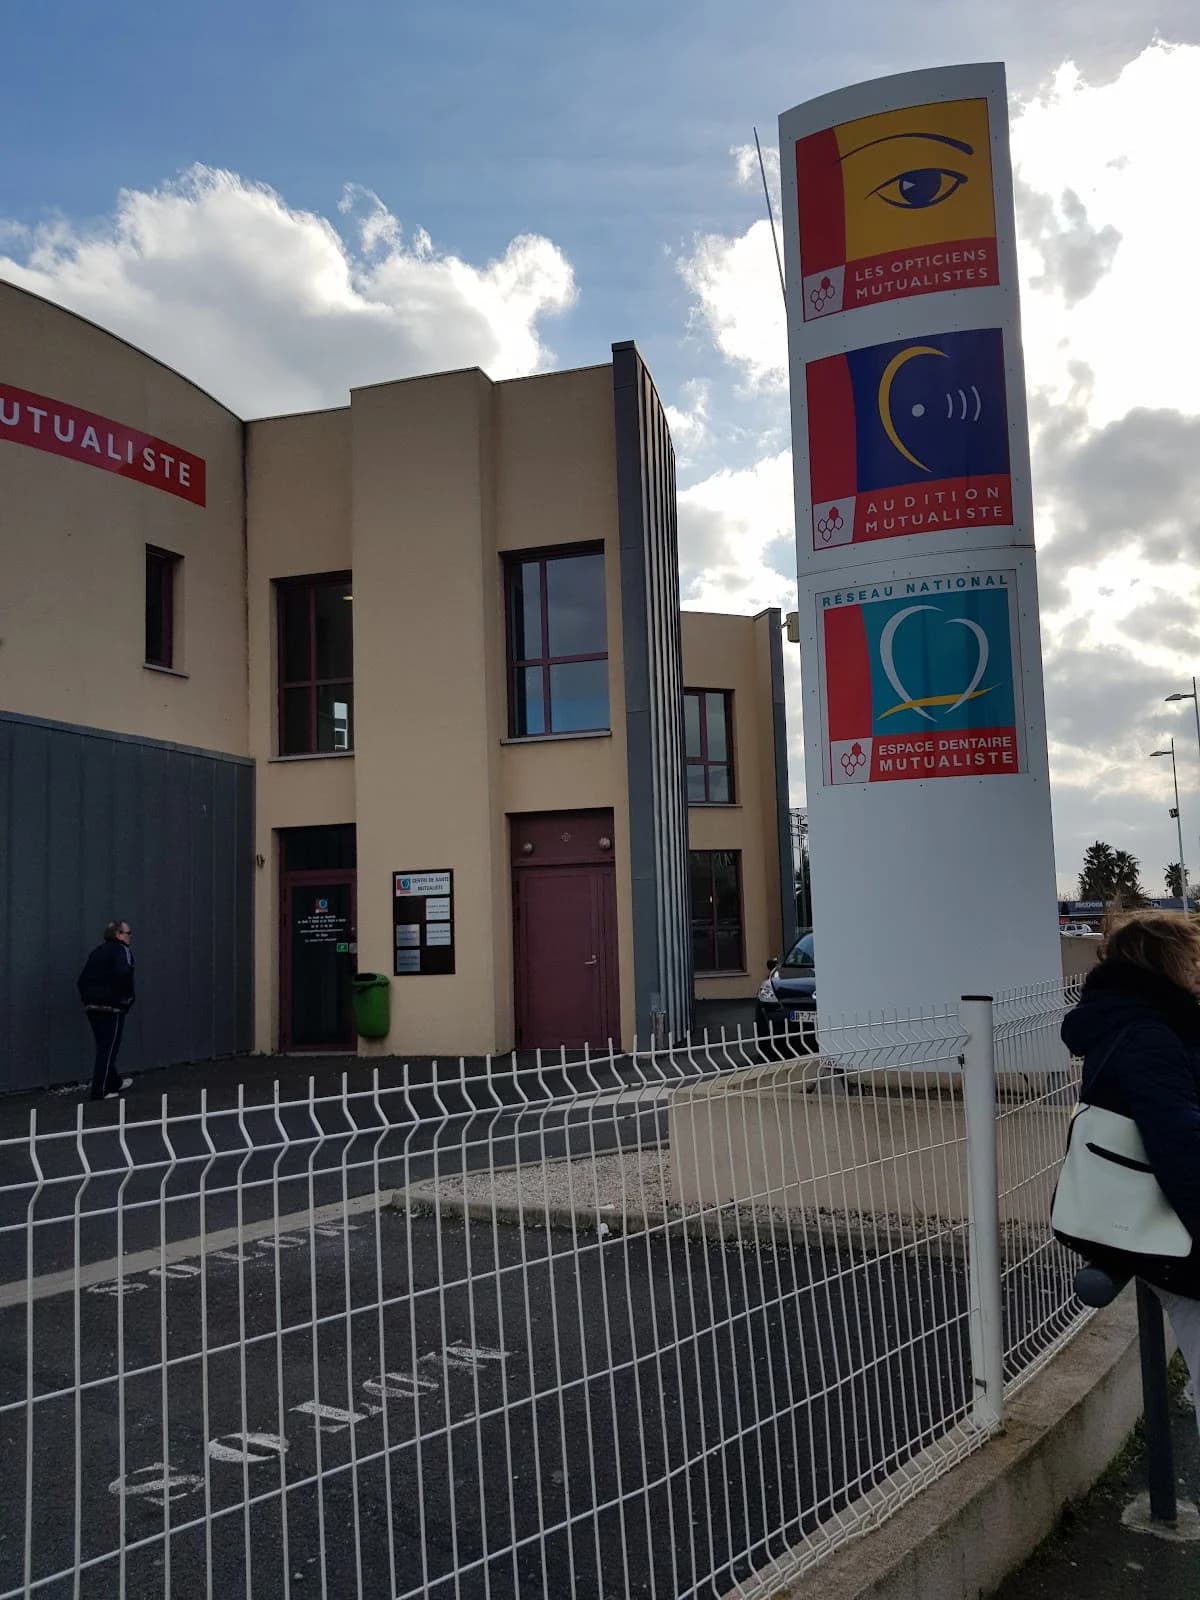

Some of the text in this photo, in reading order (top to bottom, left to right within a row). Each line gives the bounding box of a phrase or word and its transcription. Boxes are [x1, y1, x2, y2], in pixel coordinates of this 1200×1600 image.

[855, 248, 987, 282] LES OPTICIENS
[856, 267, 988, 300] MUTUALISTES
[866, 487, 1000, 515] AUDITION
[865, 505, 1003, 533] MUTUALISTE
[822, 574, 1009, 608] RÉSEAU NATIONAL
[878, 736, 1012, 756] ESPACE DENTAIRE
[878, 751, 1014, 772] MUTUALISTE
